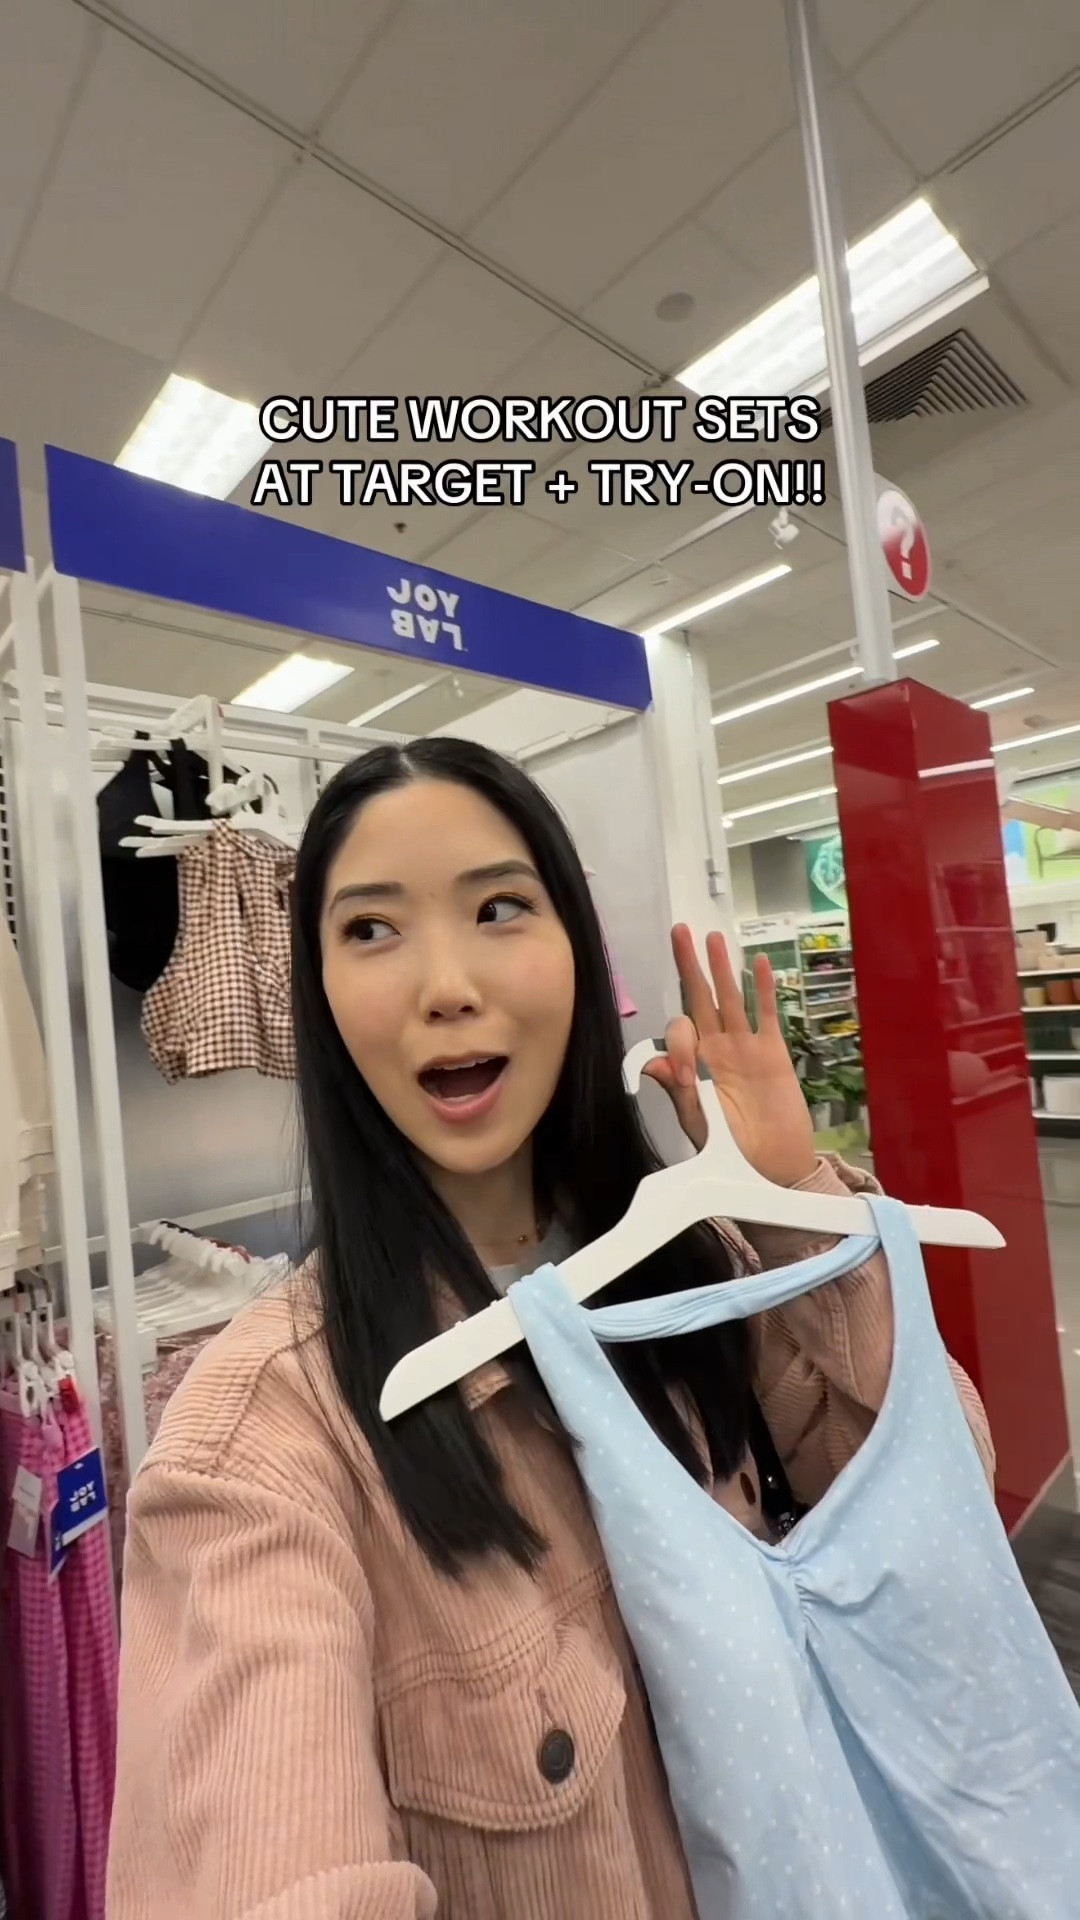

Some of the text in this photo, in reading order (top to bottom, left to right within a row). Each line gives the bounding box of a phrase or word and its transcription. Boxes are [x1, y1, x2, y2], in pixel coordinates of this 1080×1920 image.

[386, 578, 460, 618] JOY
[390, 608, 462, 651] LAB
[69, 1480, 95, 1502] JOY
